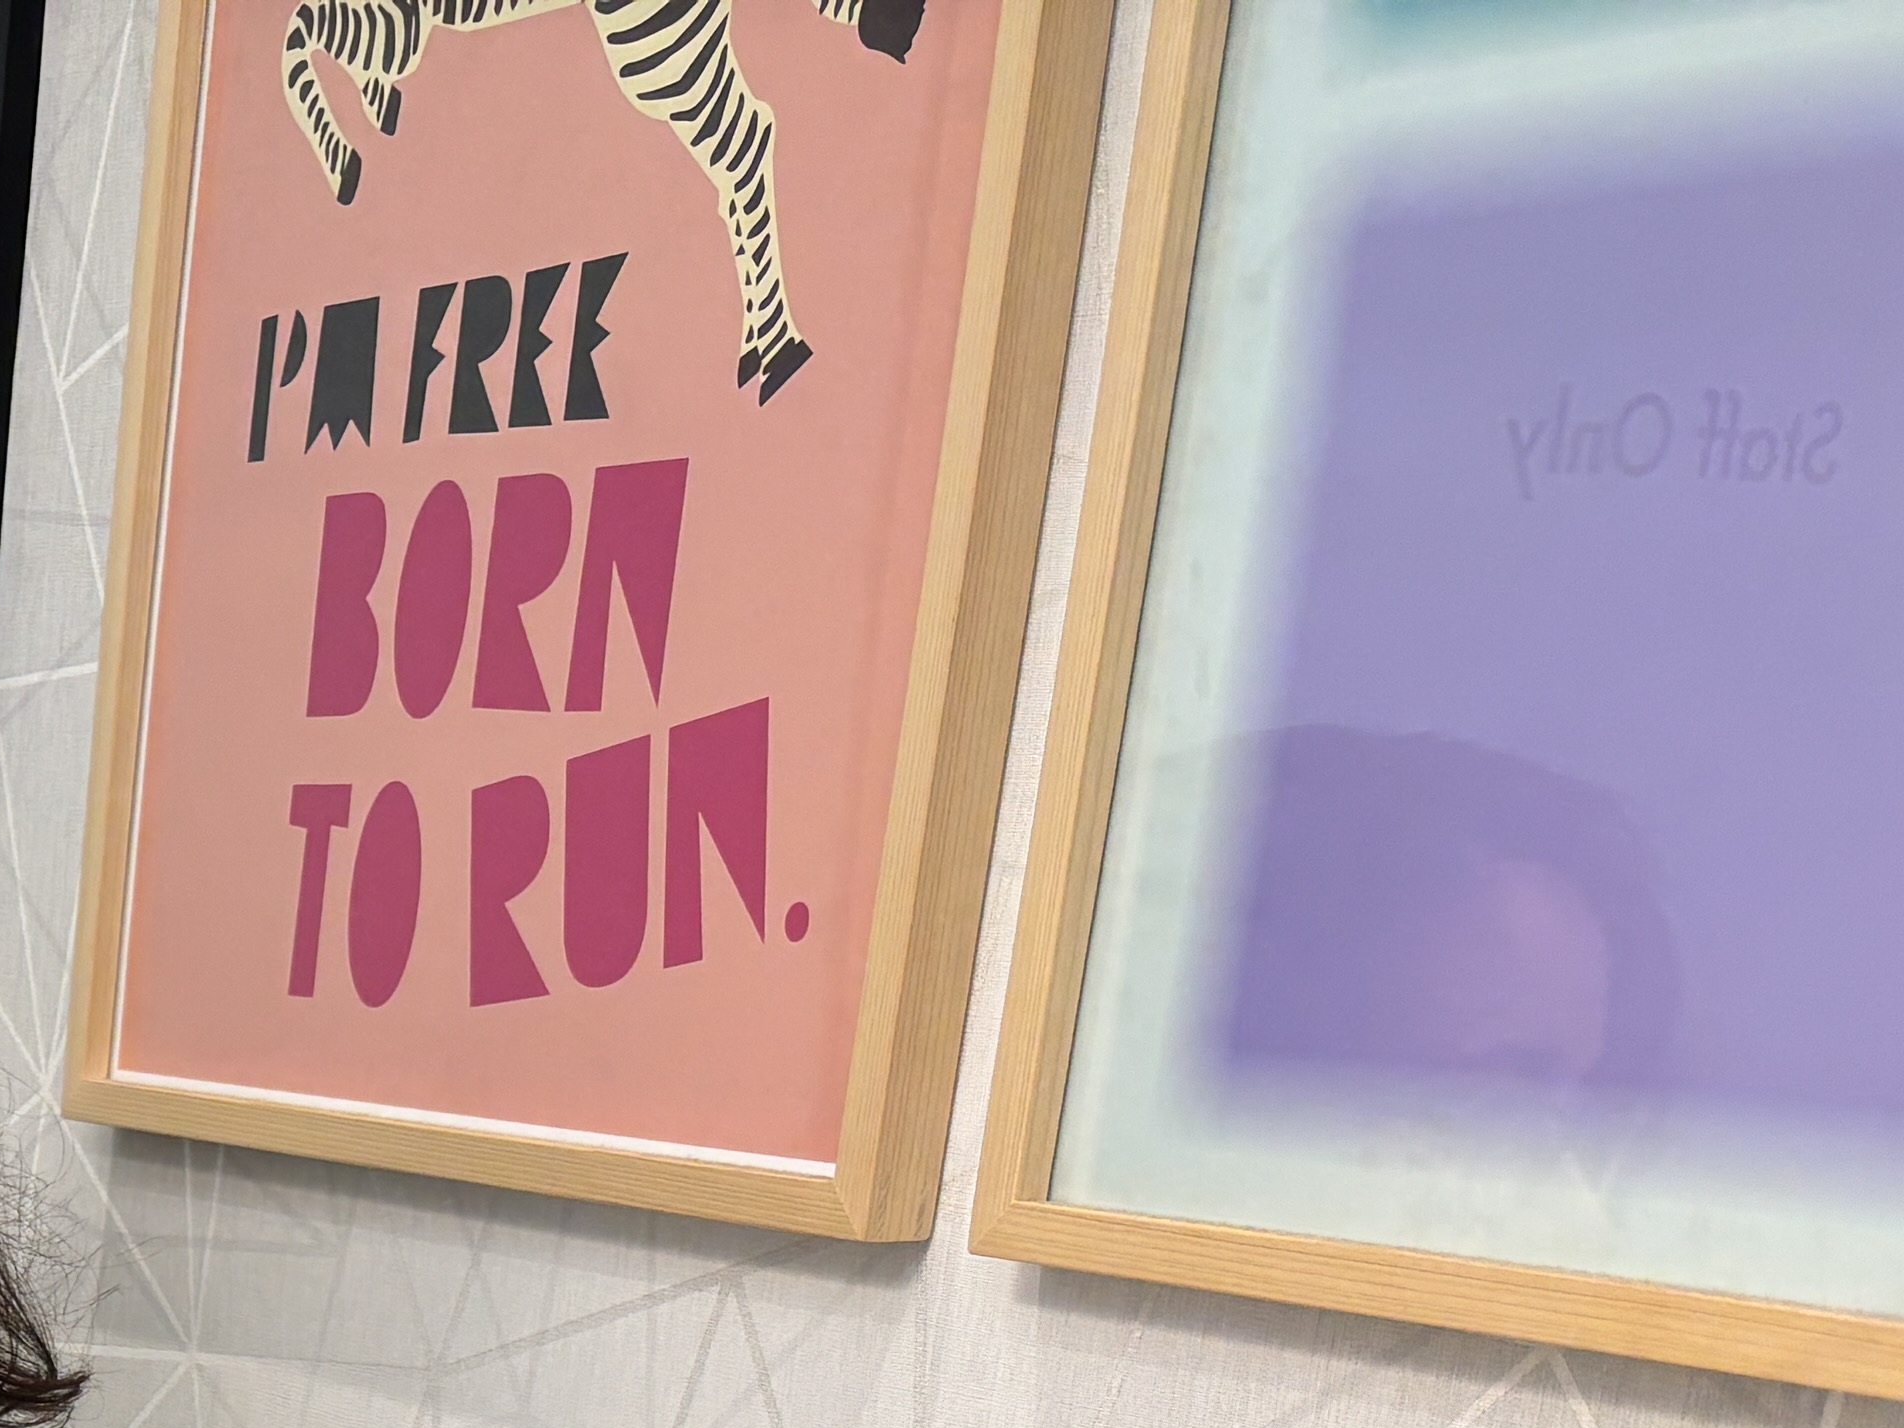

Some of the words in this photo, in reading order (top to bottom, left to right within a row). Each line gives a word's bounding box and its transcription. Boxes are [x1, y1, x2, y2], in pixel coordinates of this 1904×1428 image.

[402, 252, 629, 444] FREE
[306, 457, 689, 719] BORN
[288, 781, 422, 1008] TO
[469, 696, 810, 1008] RUN.
